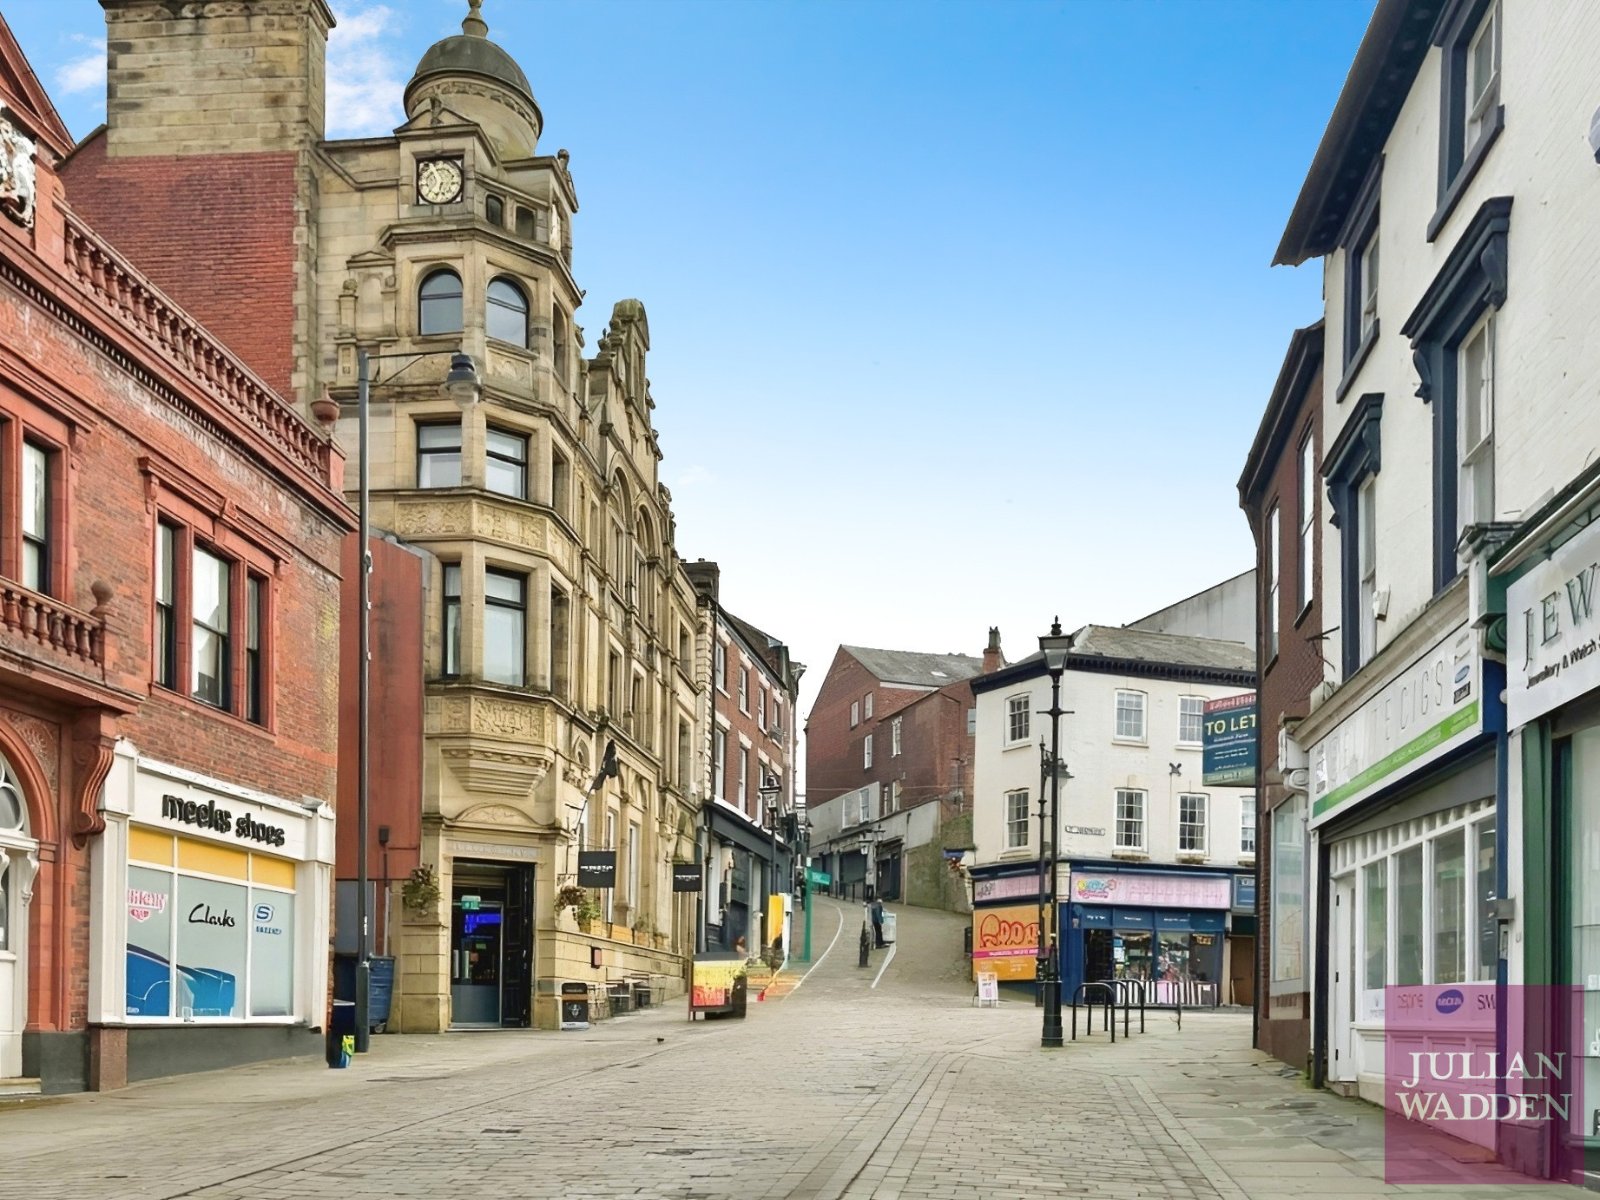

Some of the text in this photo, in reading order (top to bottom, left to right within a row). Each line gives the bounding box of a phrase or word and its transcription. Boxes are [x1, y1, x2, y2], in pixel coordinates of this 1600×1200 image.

[1205, 714, 1256, 736] TO LET
[162, 794, 285, 847] meeks shoes
[188, 903, 236, 928] Clarks
